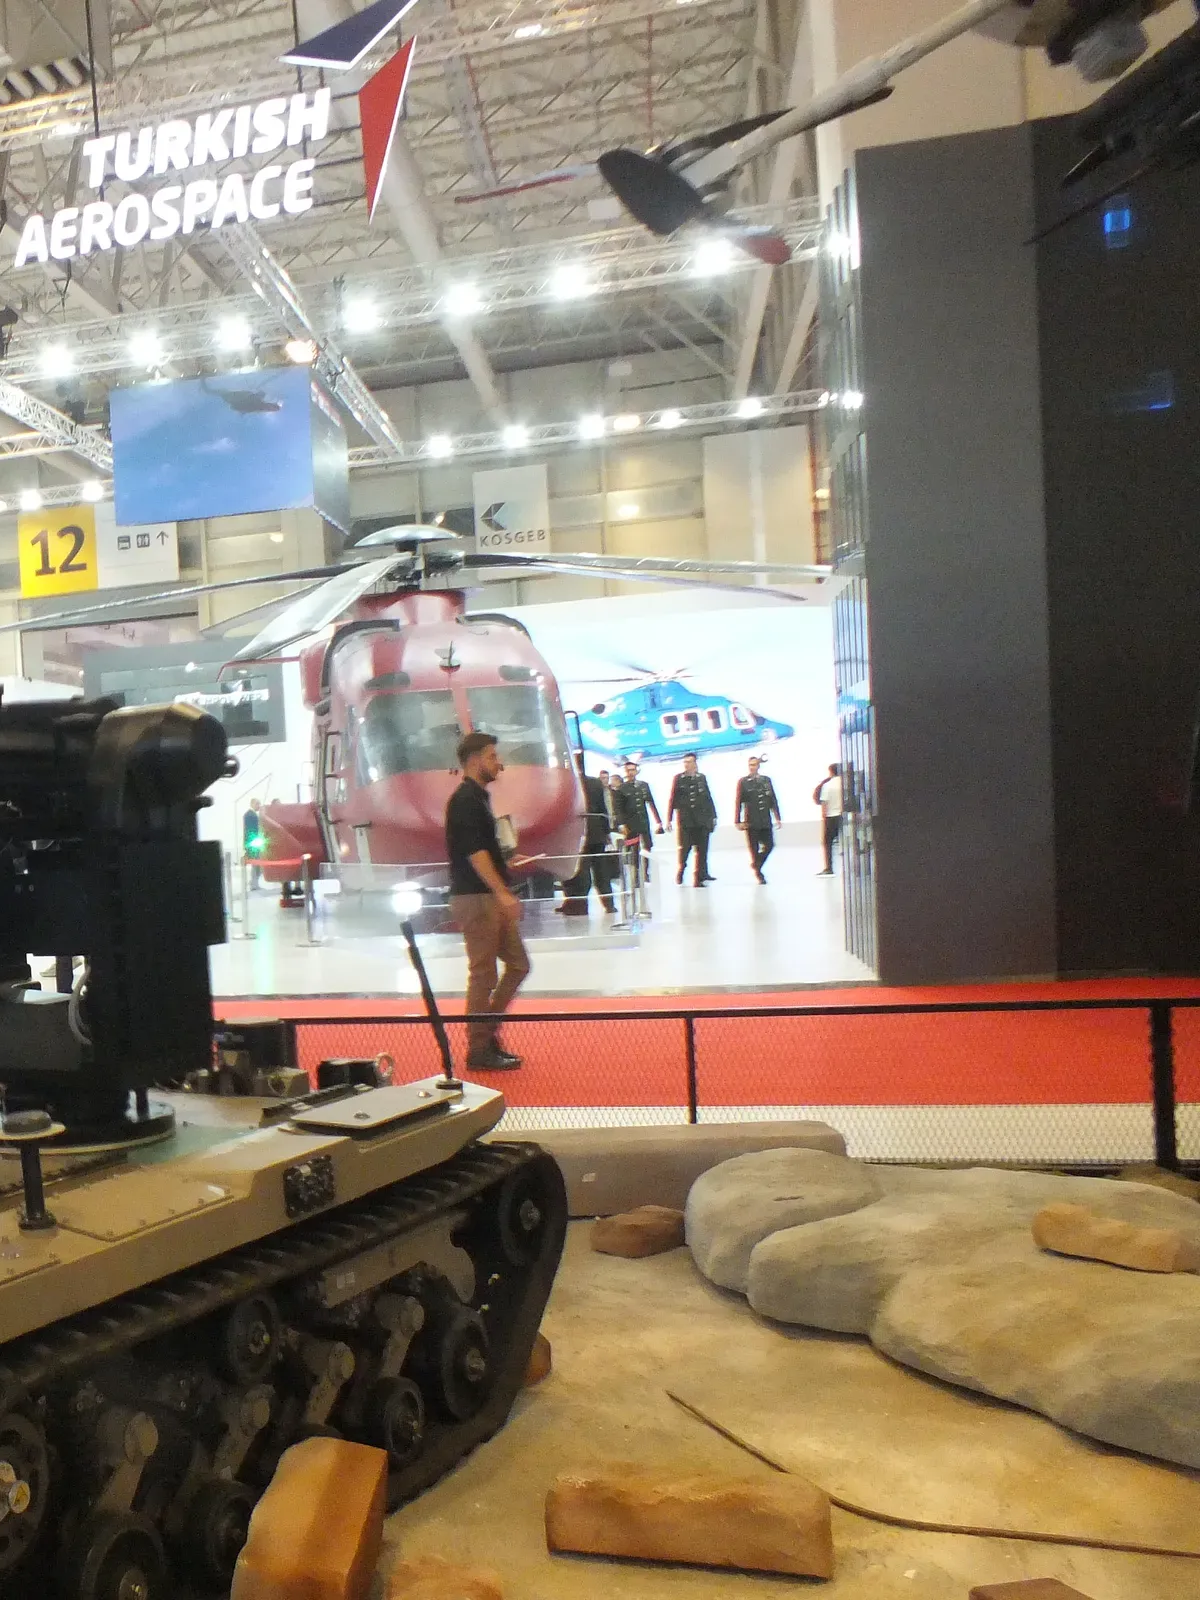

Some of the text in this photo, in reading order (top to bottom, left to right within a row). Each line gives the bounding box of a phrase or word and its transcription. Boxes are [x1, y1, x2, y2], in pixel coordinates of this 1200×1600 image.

[82, 87, 331, 189] TURKISH
[14, 158, 315, 268] AEROSPACE
[30, 524, 87, 577] 12
[480, 529, 546, 547] KOSGEB
